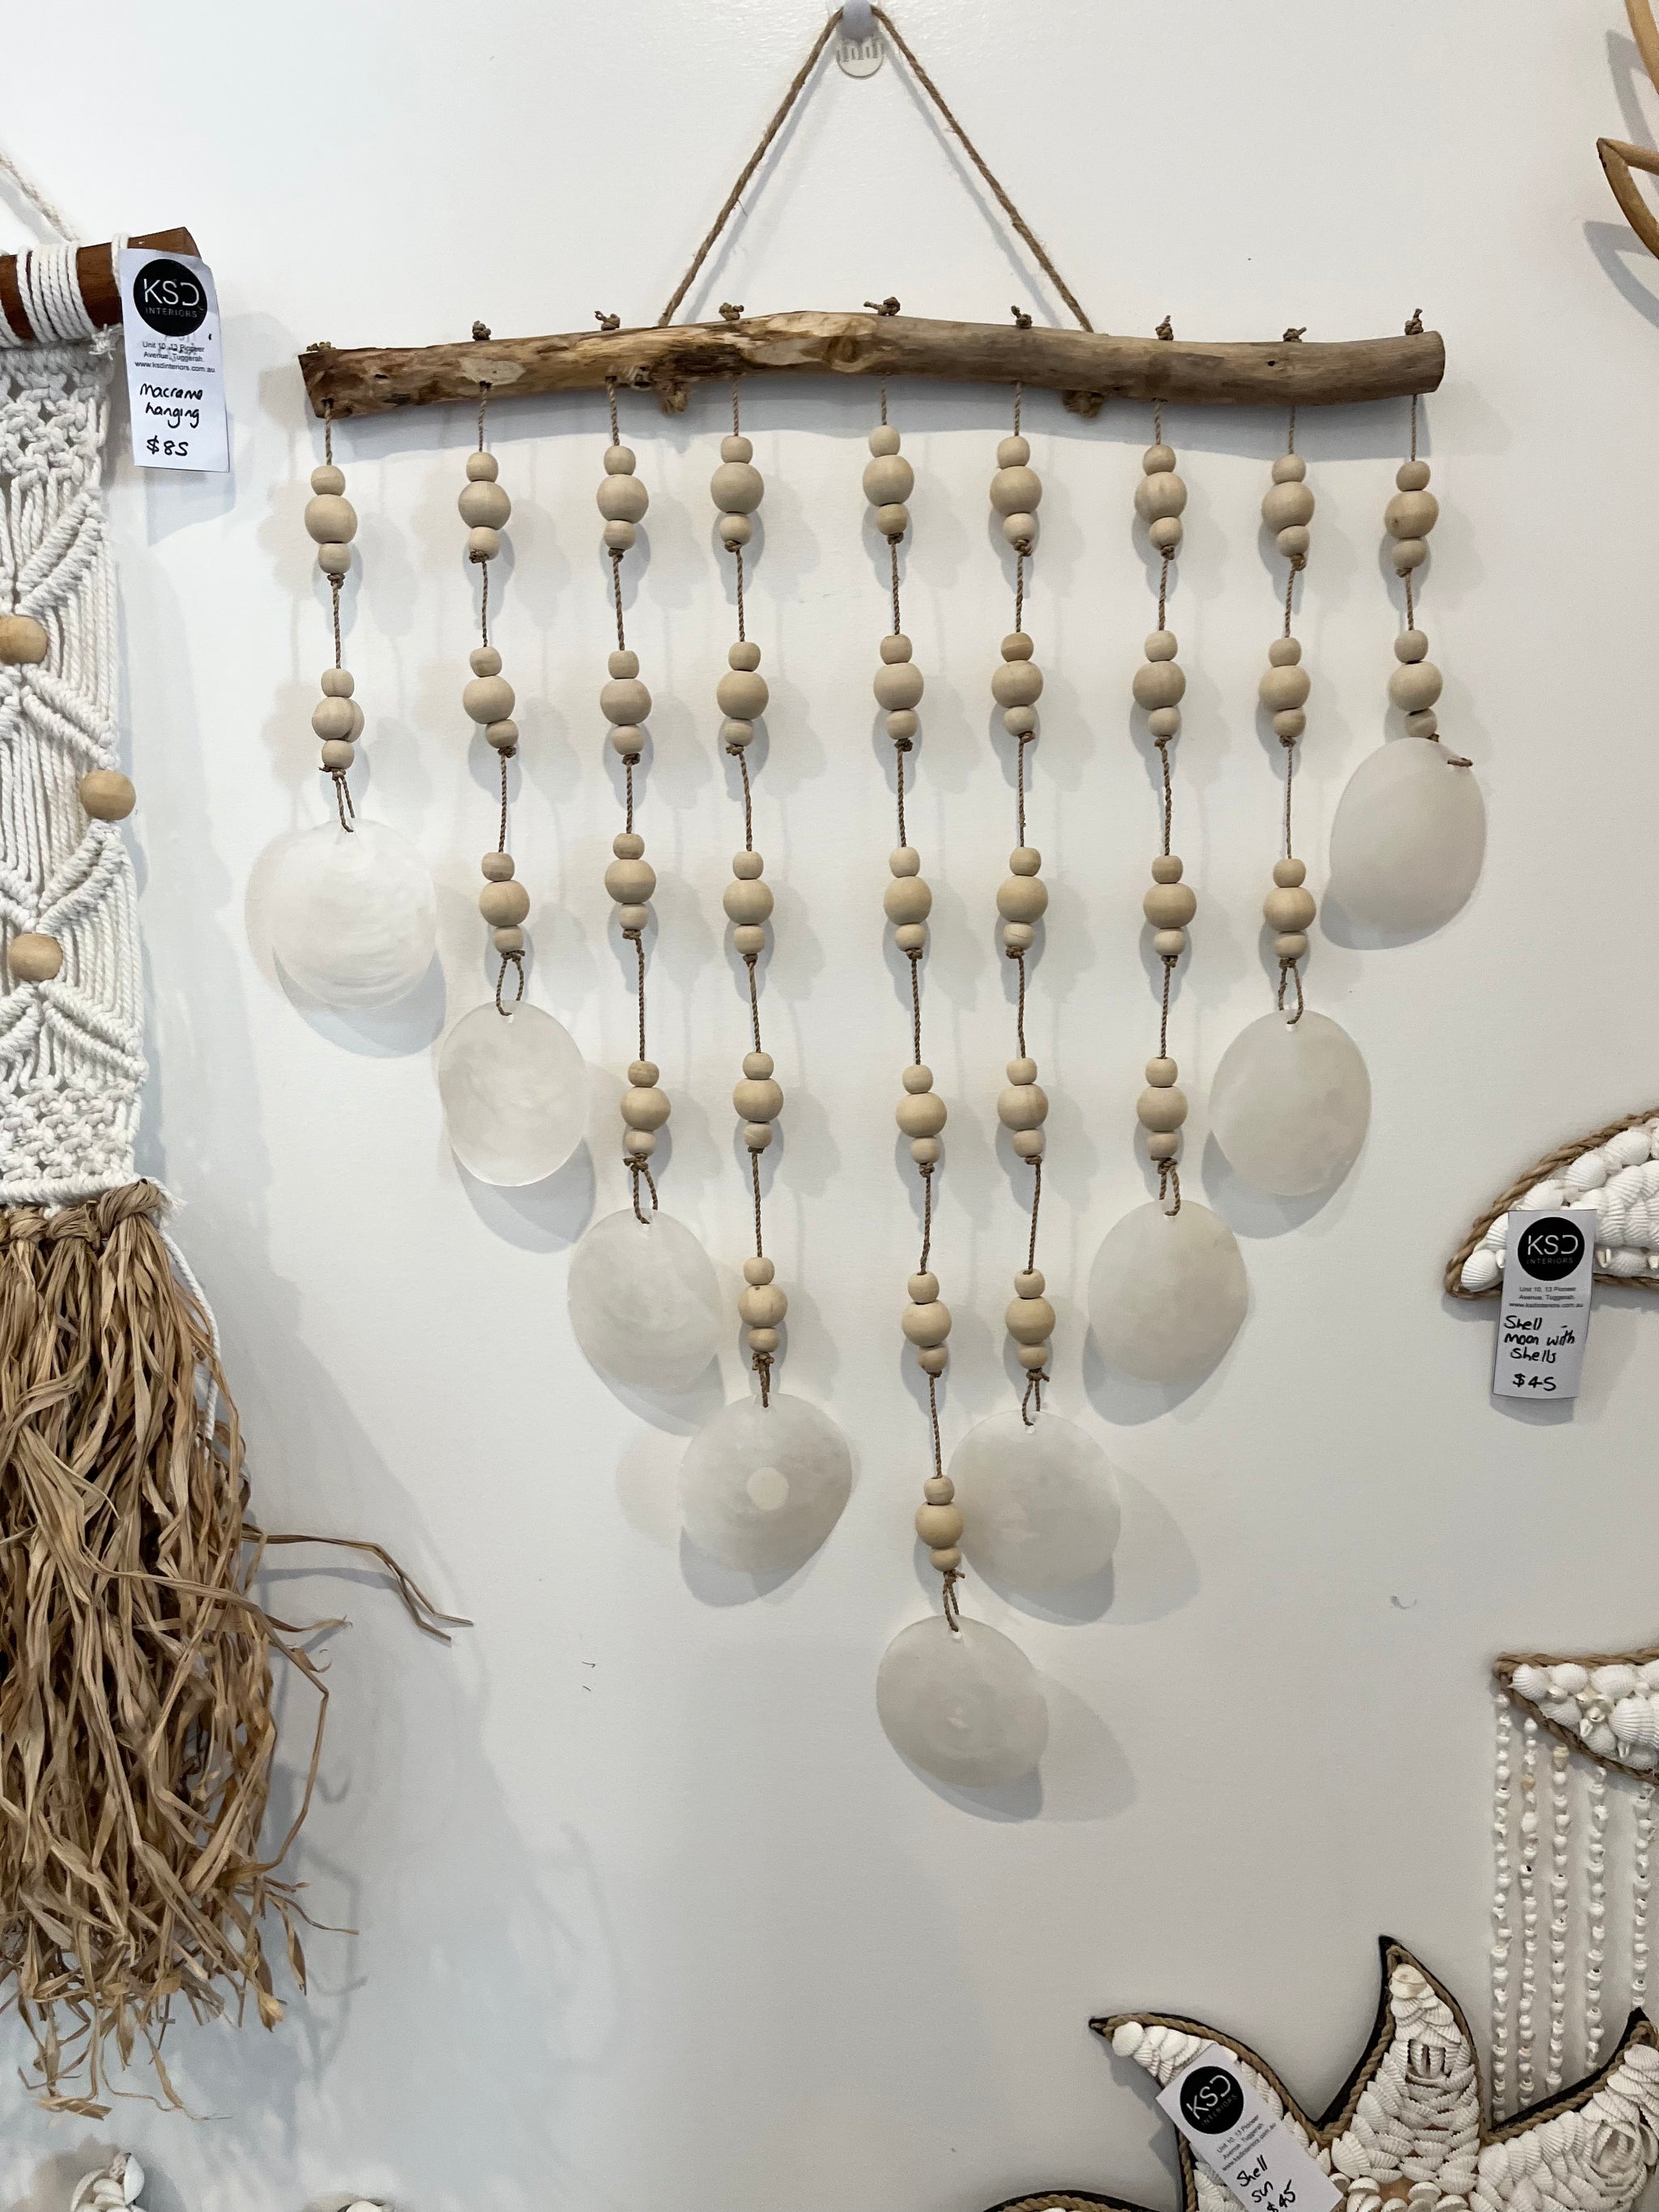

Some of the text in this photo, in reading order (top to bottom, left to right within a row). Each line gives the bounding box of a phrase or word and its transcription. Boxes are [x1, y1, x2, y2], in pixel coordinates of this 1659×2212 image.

[143, 278, 200, 306] KSD
[145, 307, 198, 319] INTERIORS
[145, 402, 200, 428] hanging
[147, 435, 189, 457] $85
[1527, 1234, 1579, 1255] KSD
[1526, 1257, 1574, 1265] INTERIORS
[1503, 1315, 1542, 1330] Shell
[1546, 1326, 1576, 1346] with
[1512, 1373, 1557, 1392] $45
[1186, 2074, 1231, 2120] KSD
[1236, 2154, 1268, 2186] Shell
[1267, 2179, 1296, 2212] $45
